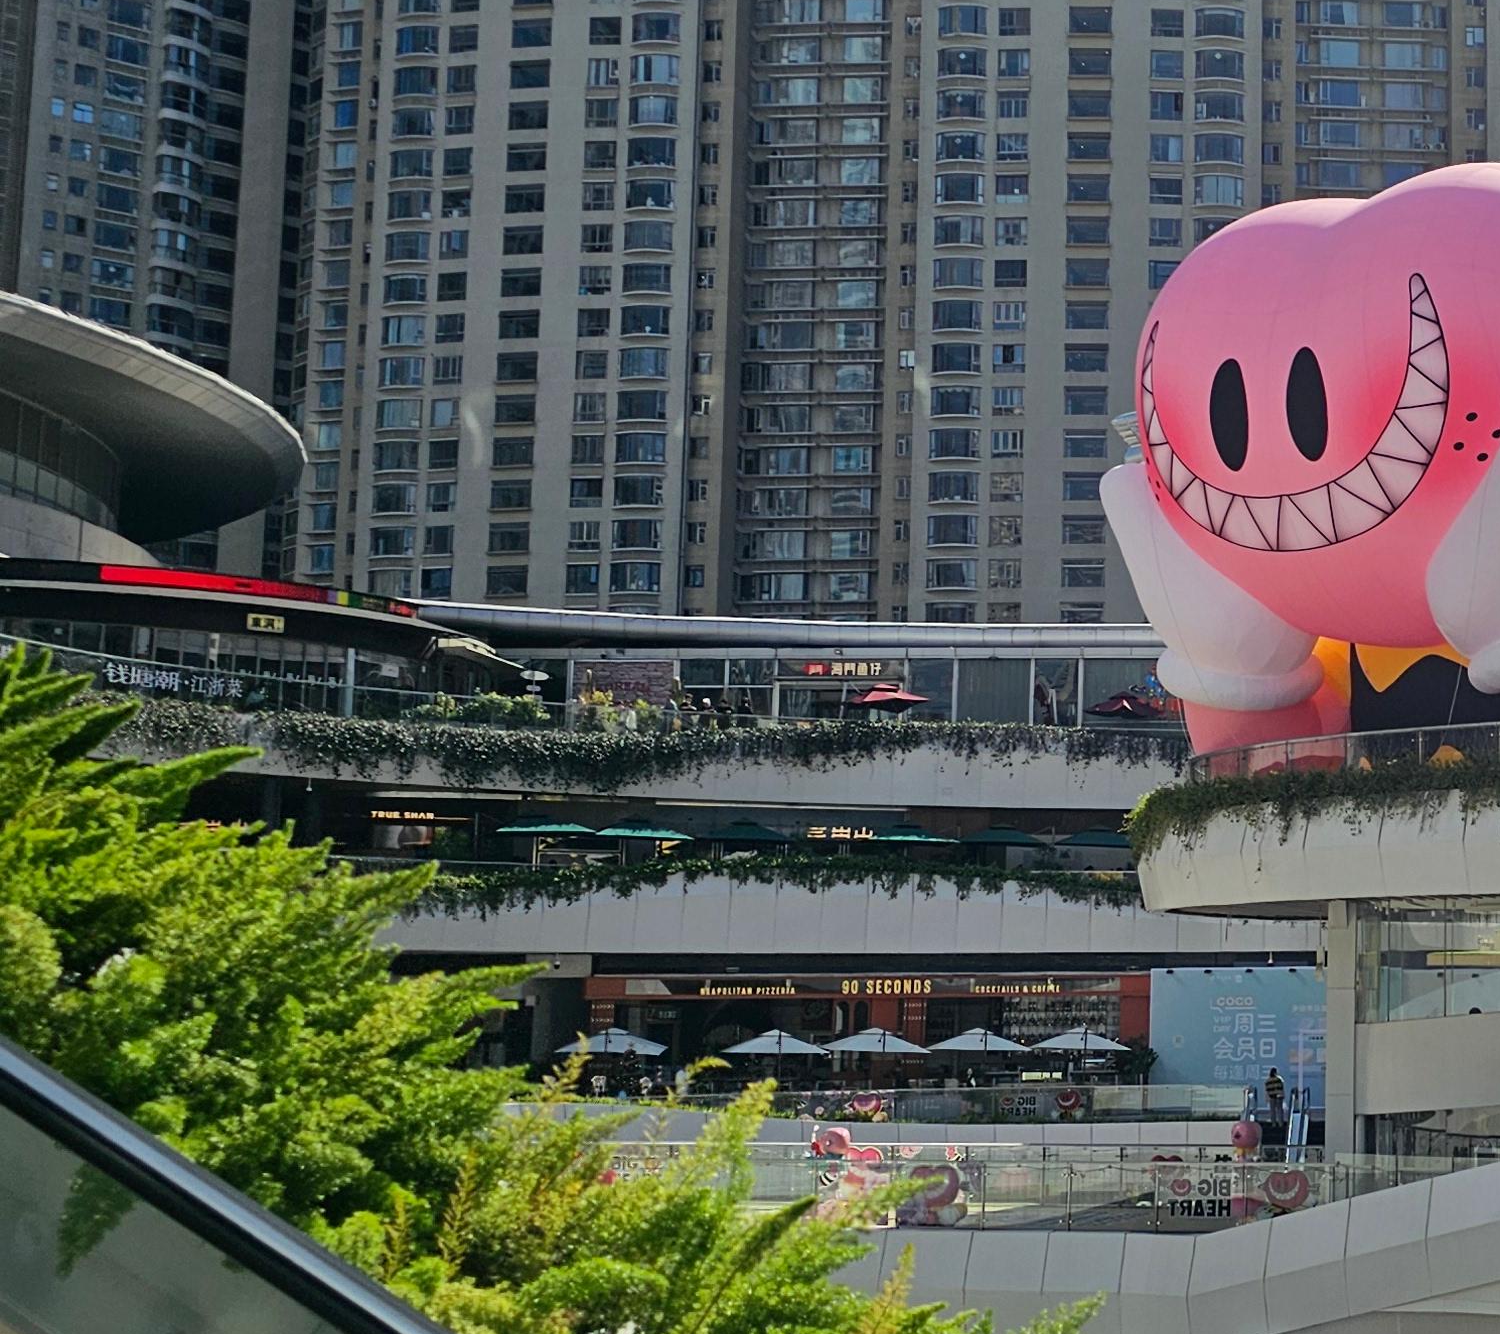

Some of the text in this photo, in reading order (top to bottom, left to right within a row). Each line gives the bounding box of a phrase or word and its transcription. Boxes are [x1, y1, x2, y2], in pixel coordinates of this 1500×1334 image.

[841, 978, 932, 995] 90 SECONDS
[1233, 1012, 1277, 1034] 周三
[1213, 1036, 1276, 1061] 会员日
